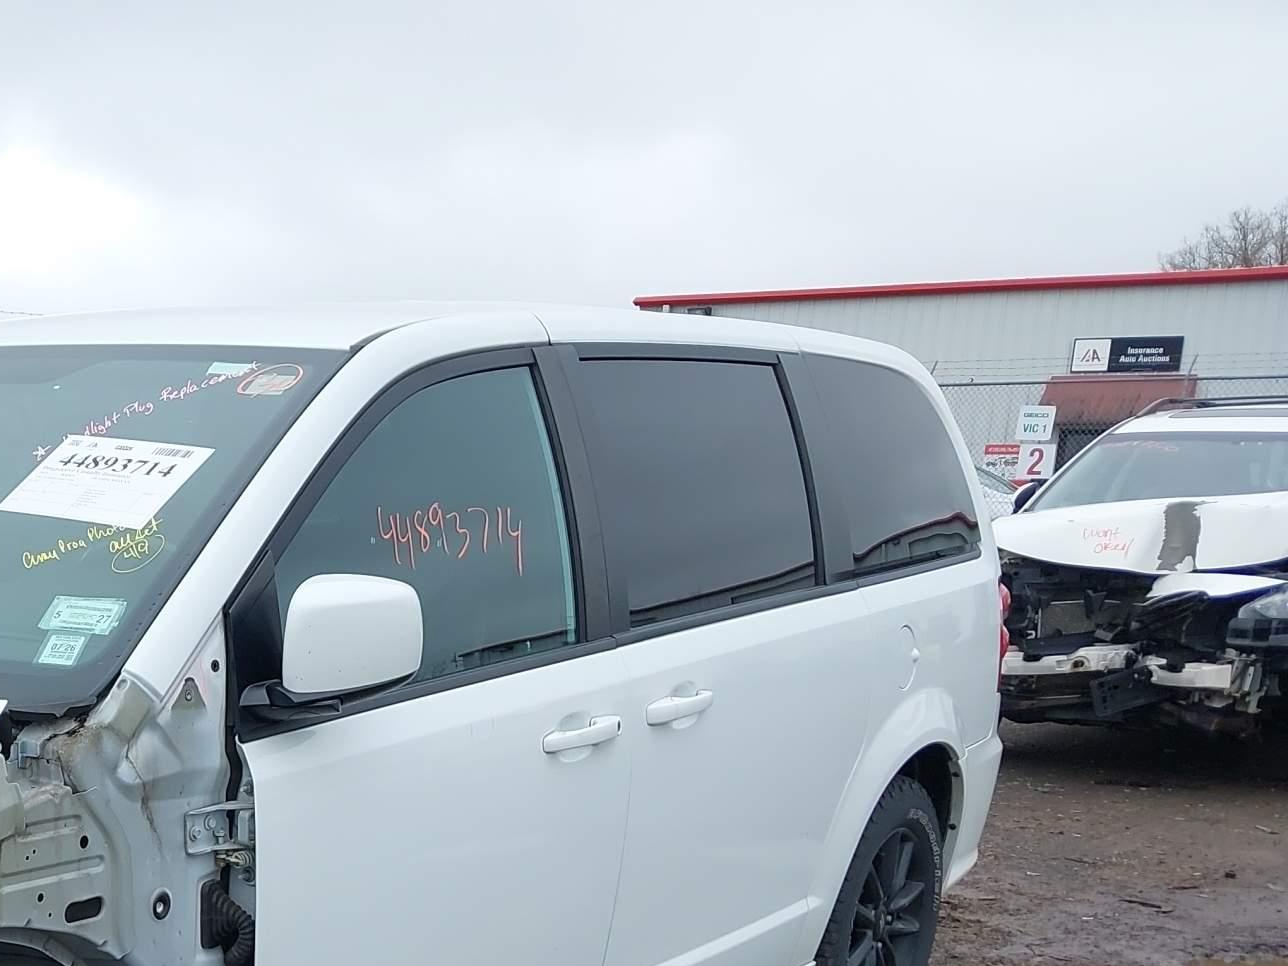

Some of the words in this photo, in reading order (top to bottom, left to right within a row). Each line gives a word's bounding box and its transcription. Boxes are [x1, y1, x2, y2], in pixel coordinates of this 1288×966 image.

[1127, 346, 1164, 354] Insurance
[1119, 355, 1136, 363] Auto
[124, 401, 154, 416] Plug
[1023, 423, 1039, 433] VIC
[1042, 424, 1047, 433] 1
[59, 452, 179, 478] 44893714
[1026, 447, 1044, 476] 2
[377, 502, 524, 577] 44893714
[53, 610, 63, 619] 5
[96, 614, 112, 624] 27
